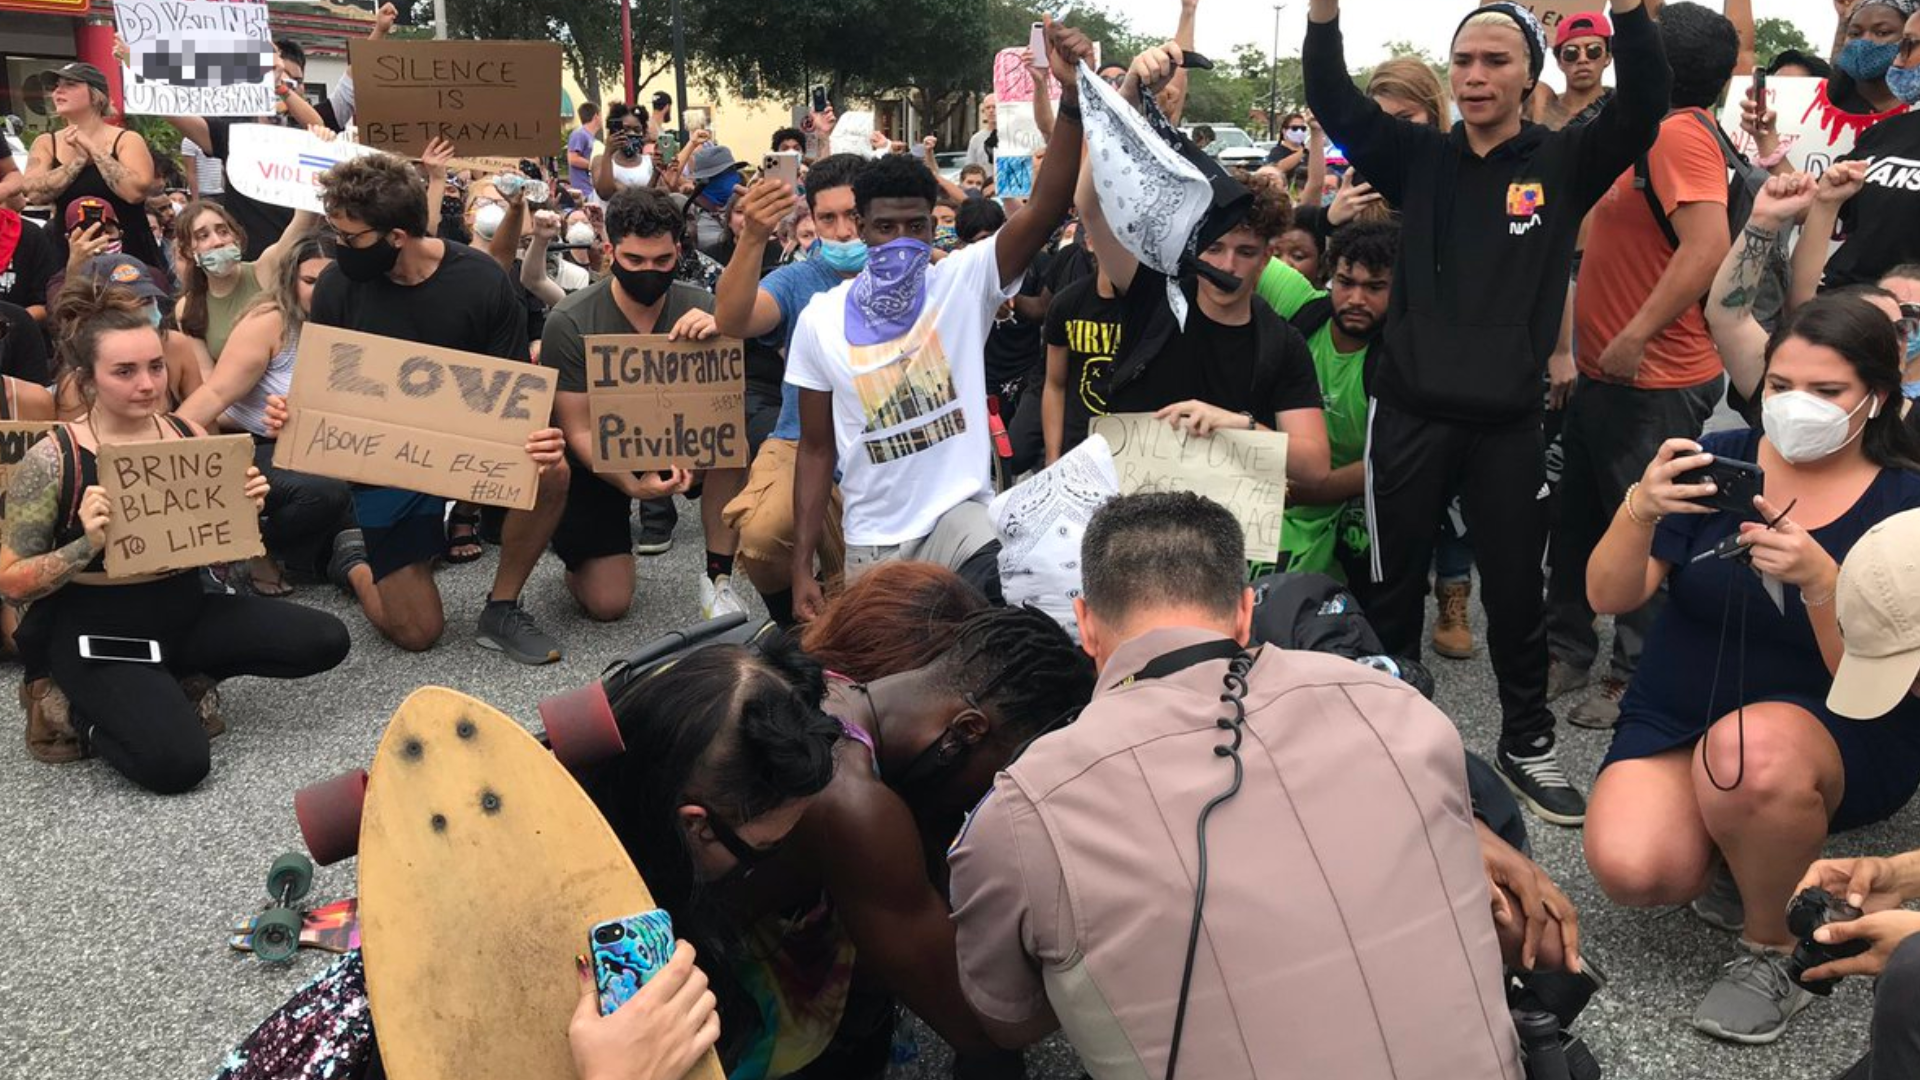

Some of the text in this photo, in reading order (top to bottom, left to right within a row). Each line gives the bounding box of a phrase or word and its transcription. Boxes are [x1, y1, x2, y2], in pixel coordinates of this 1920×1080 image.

[372, 55, 517, 83] SILENCE
[437, 90, 465, 110] IS
[366, 120, 541, 145] BETRAYAL!
[327, 342, 548, 420] LOVE
[306, 418, 518, 478] ABOVE ALL ELSE
[598, 413, 736, 467] Privilege
[1208, 432, 1275, 472] ONE
[114, 452, 222, 489] BRING
[120, 485, 226, 522] BLACK
[470, 479, 521, 502] #BLM
[113, 520, 231, 560] TO LIFE
